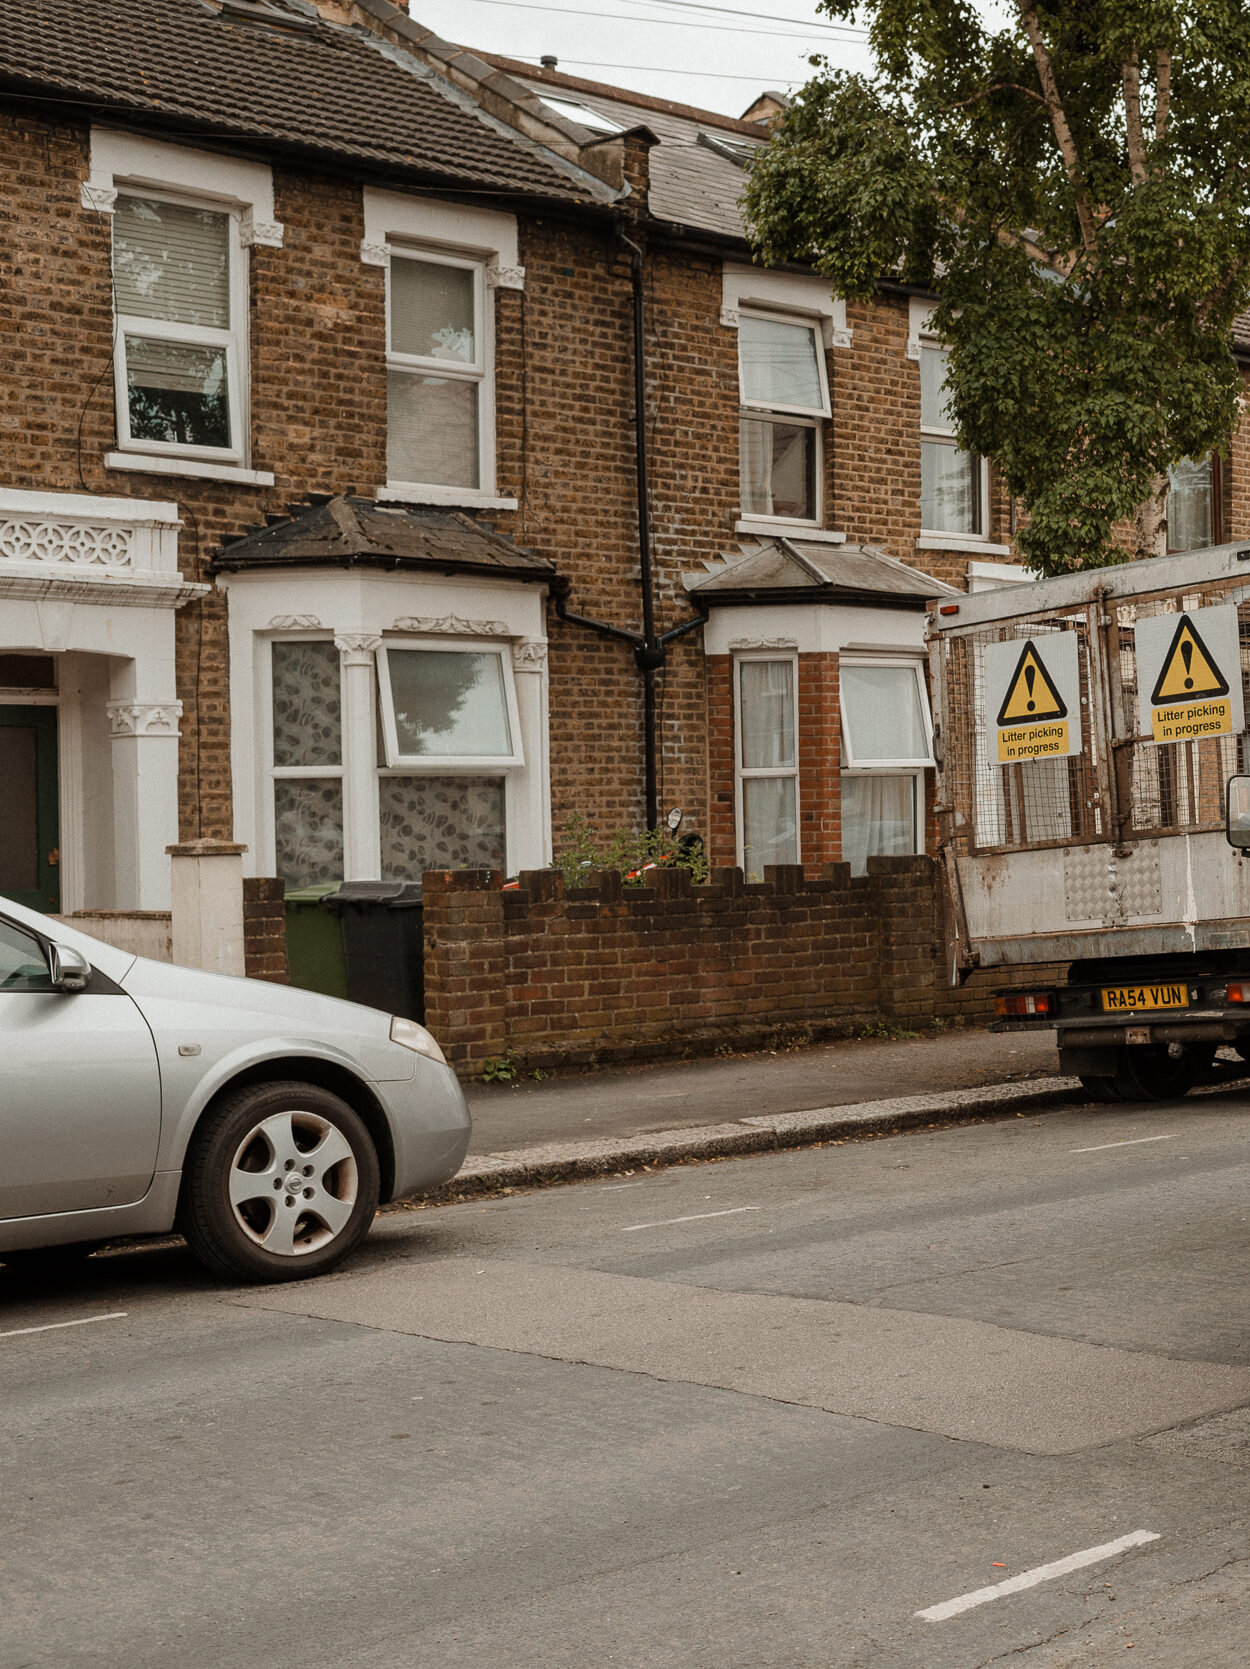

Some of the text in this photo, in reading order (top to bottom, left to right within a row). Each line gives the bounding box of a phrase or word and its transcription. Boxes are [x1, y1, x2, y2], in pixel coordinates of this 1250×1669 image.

[1157, 705, 1225, 722] Litter picking
[1002, 726, 1063, 743] Litter picking
[1163, 721, 1221, 737] in progress
[1007, 742, 1059, 757] in progress
[1107, 986, 1181, 1008] RA54 VUN
